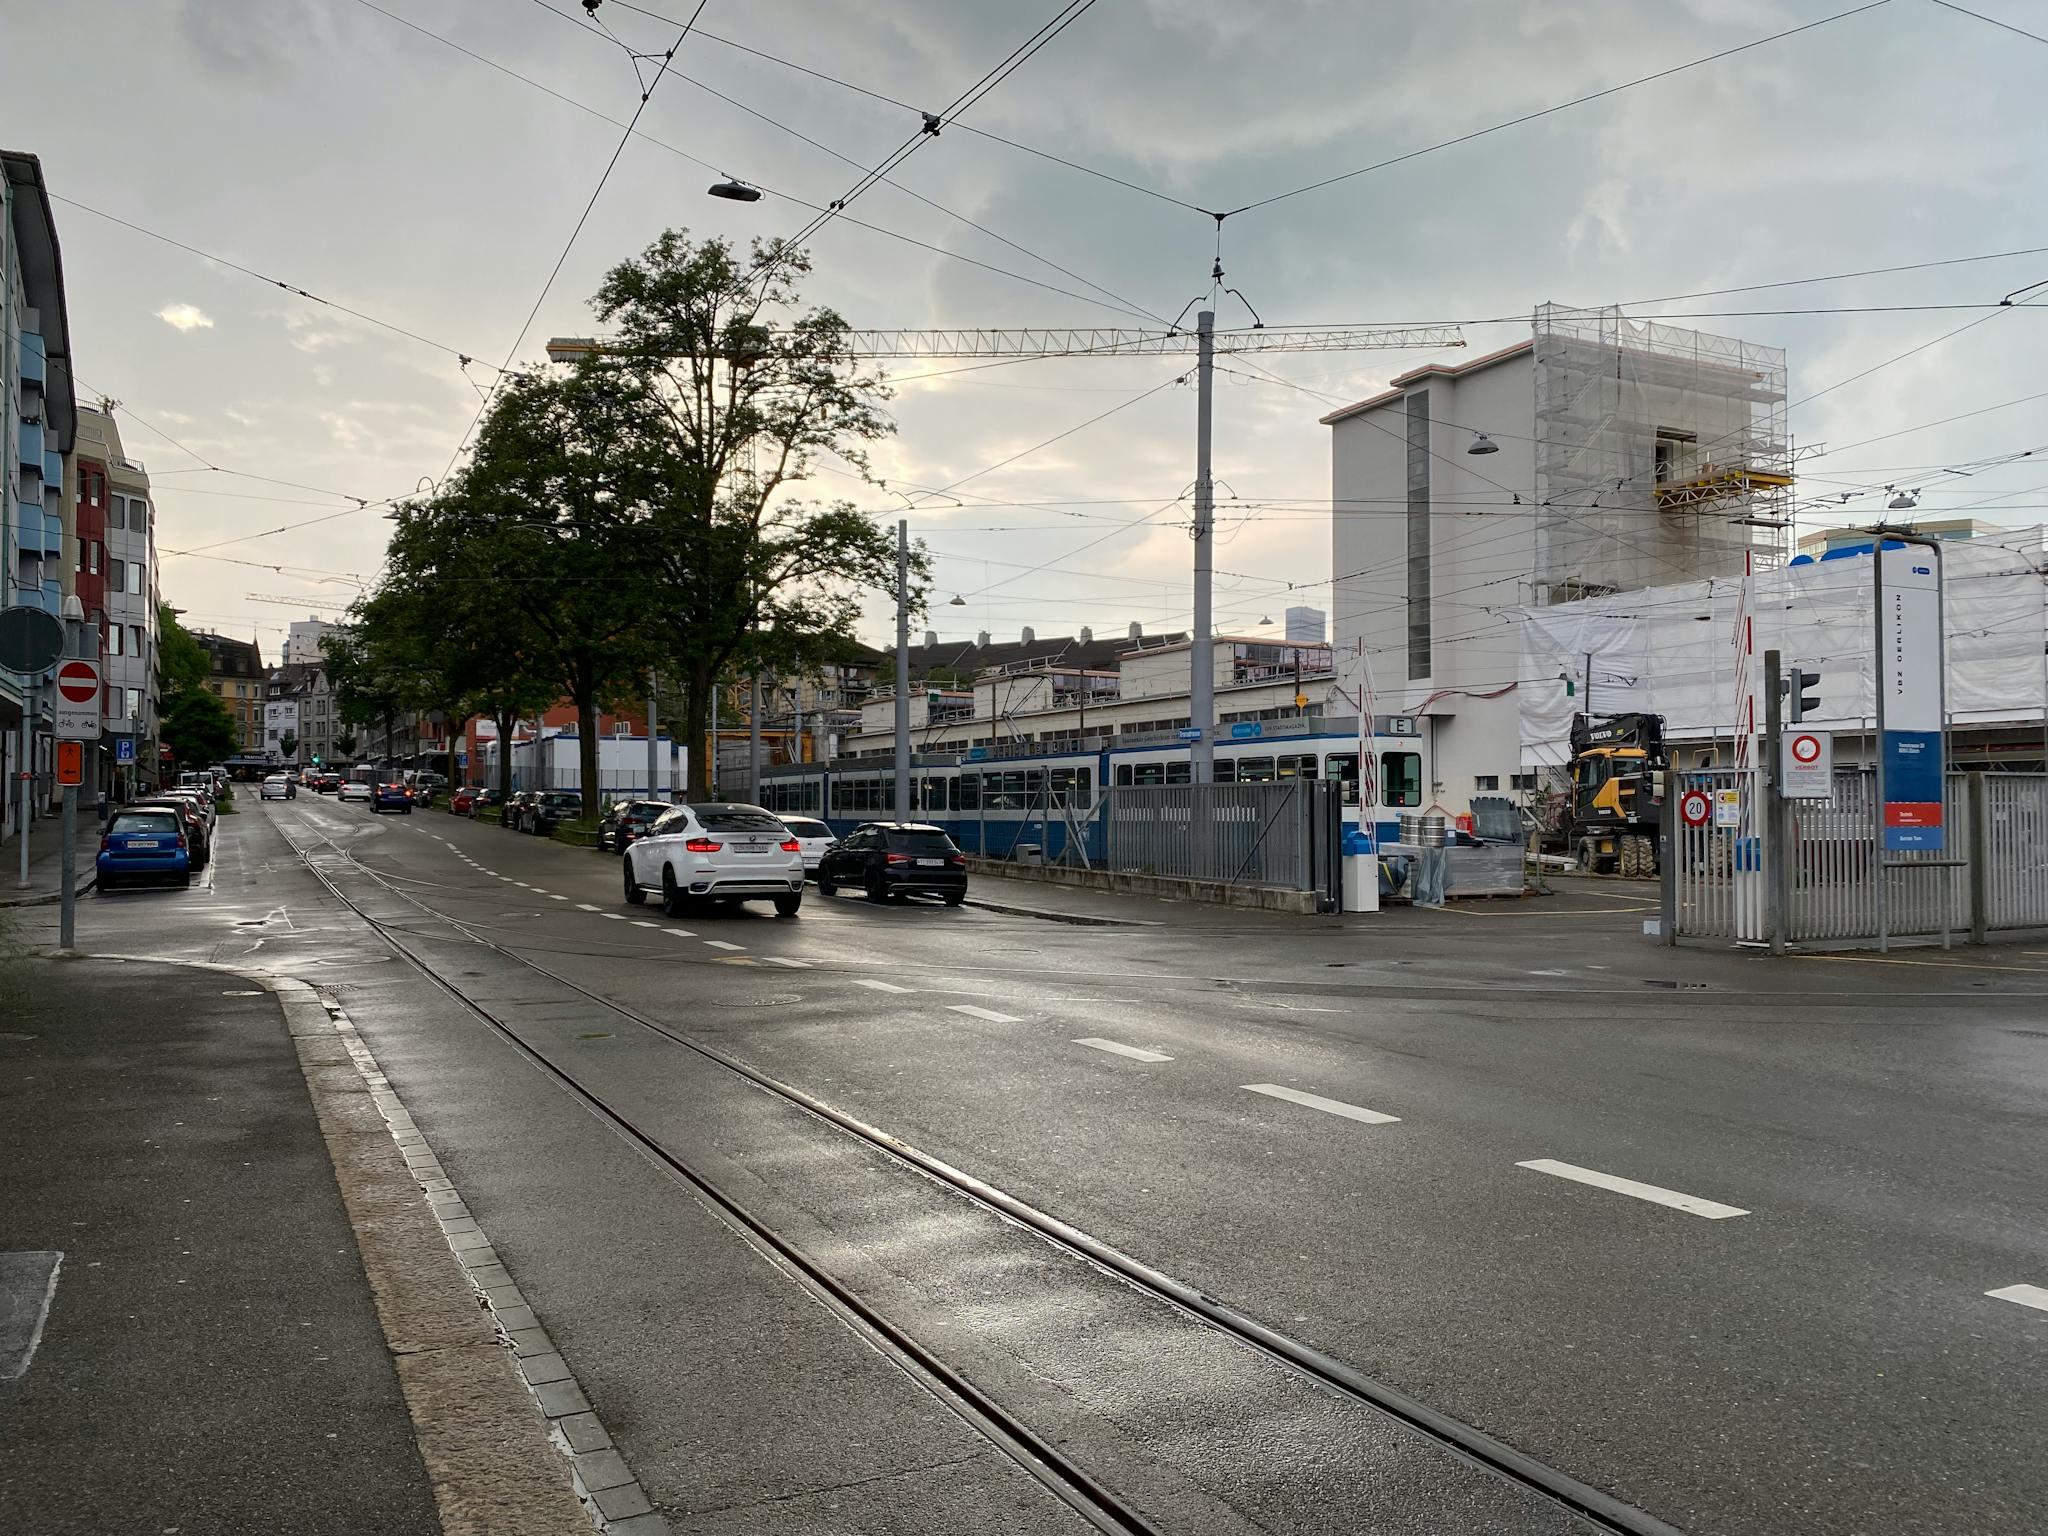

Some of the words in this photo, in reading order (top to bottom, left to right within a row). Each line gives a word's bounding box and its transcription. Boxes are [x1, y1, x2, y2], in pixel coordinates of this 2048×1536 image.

[1396, 719, 1405, 732] E
[1590, 730, 1612, 740] VOLVO
[121, 741, 130, 751] P
[1689, 802, 1702, 815] 20
